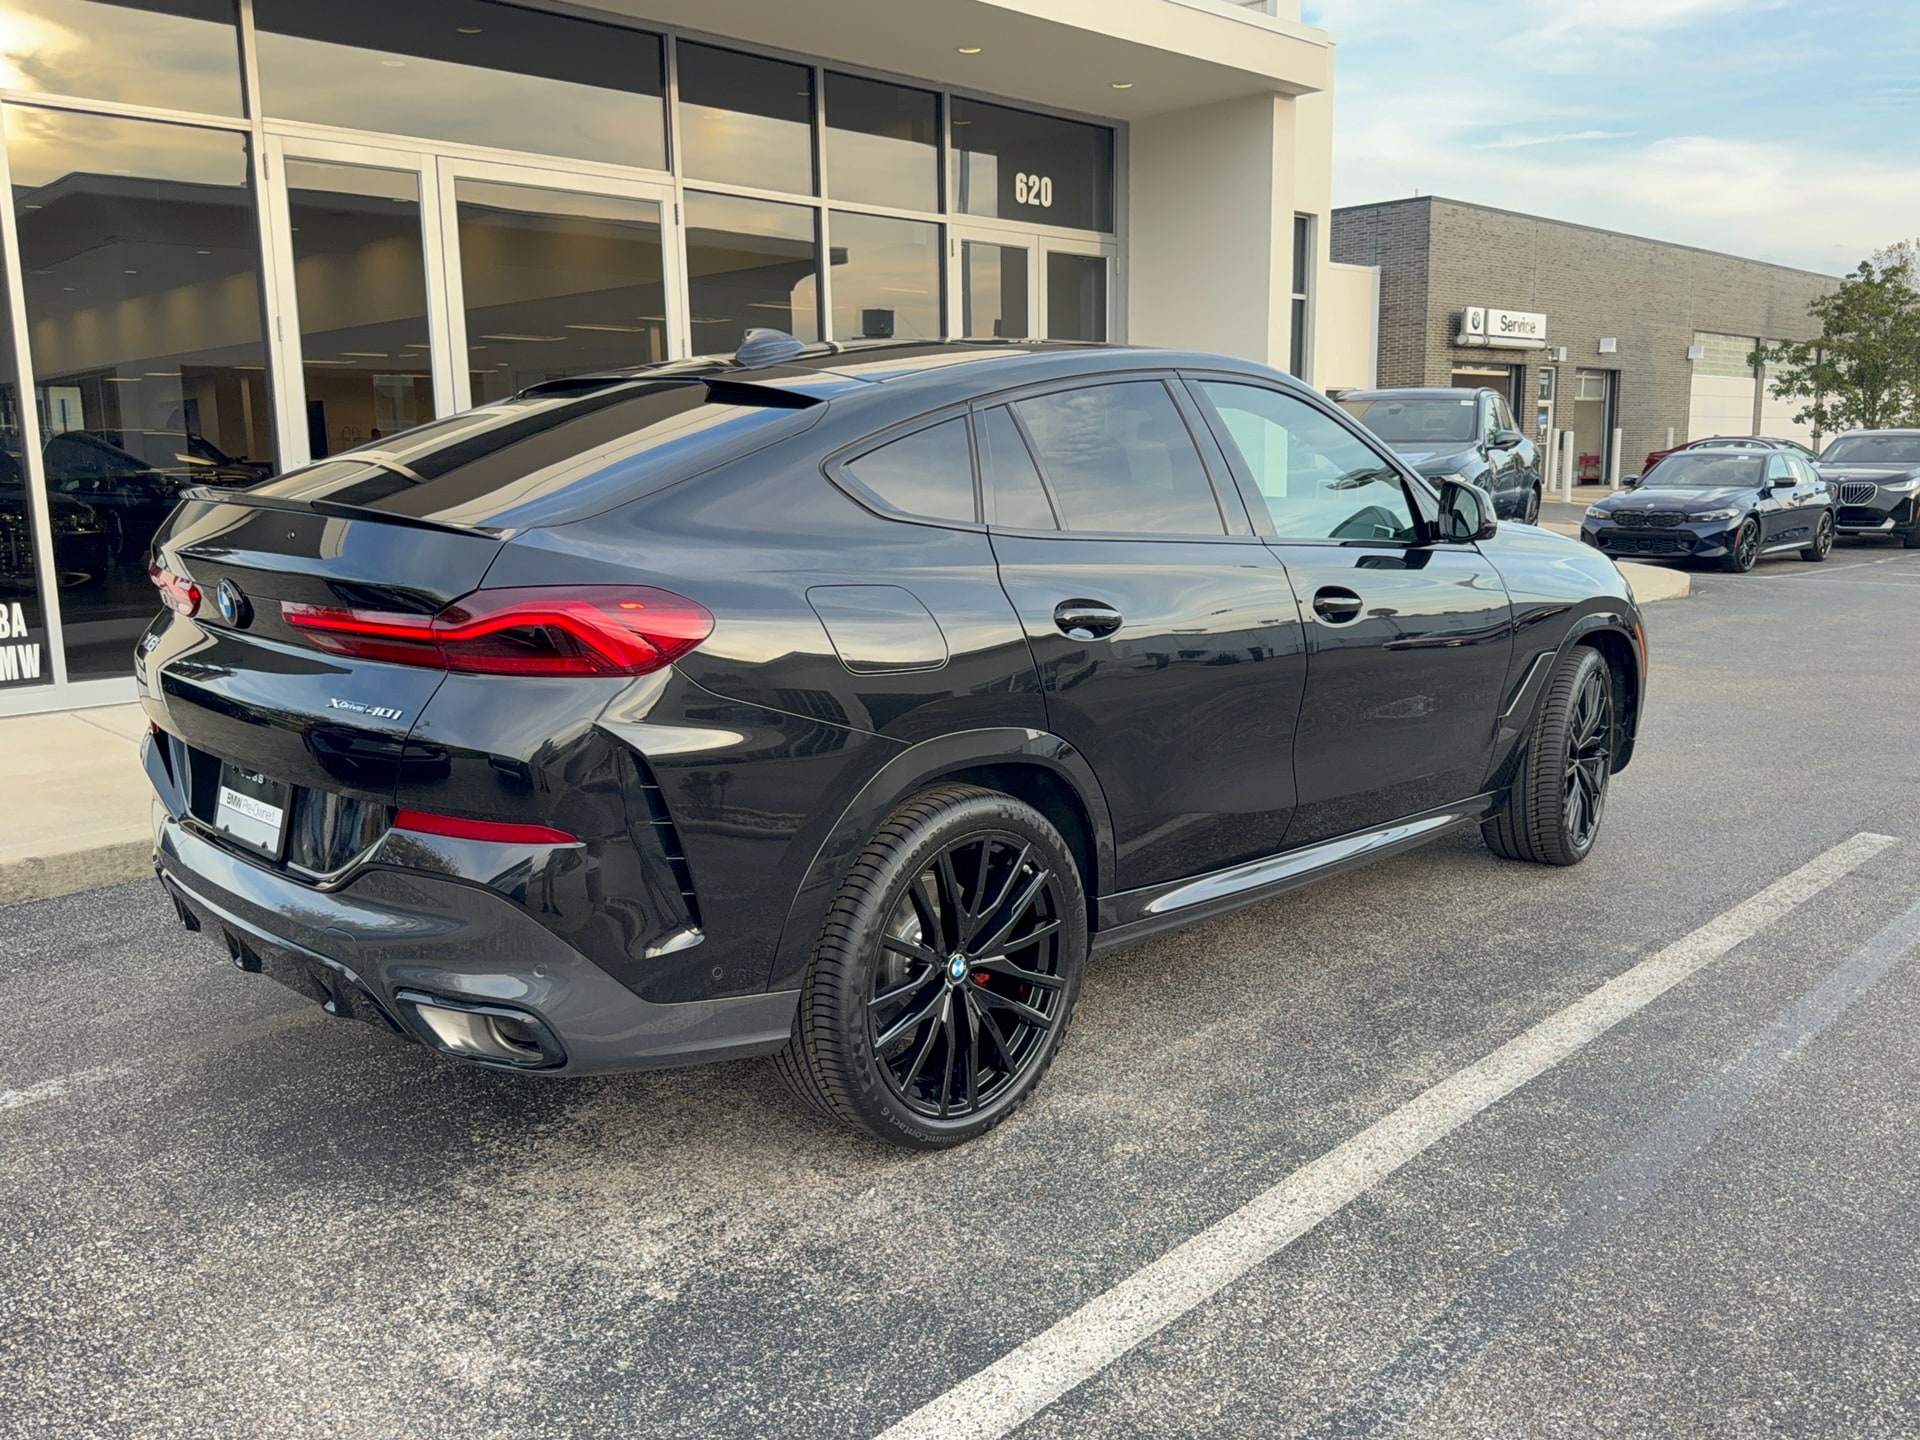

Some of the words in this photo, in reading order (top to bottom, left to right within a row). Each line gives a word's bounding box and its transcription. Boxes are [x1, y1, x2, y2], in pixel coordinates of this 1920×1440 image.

[1015, 172, 1053, 207] 620
[1500, 315, 1536, 334] Service
[226, 792, 241, 808] BMW
